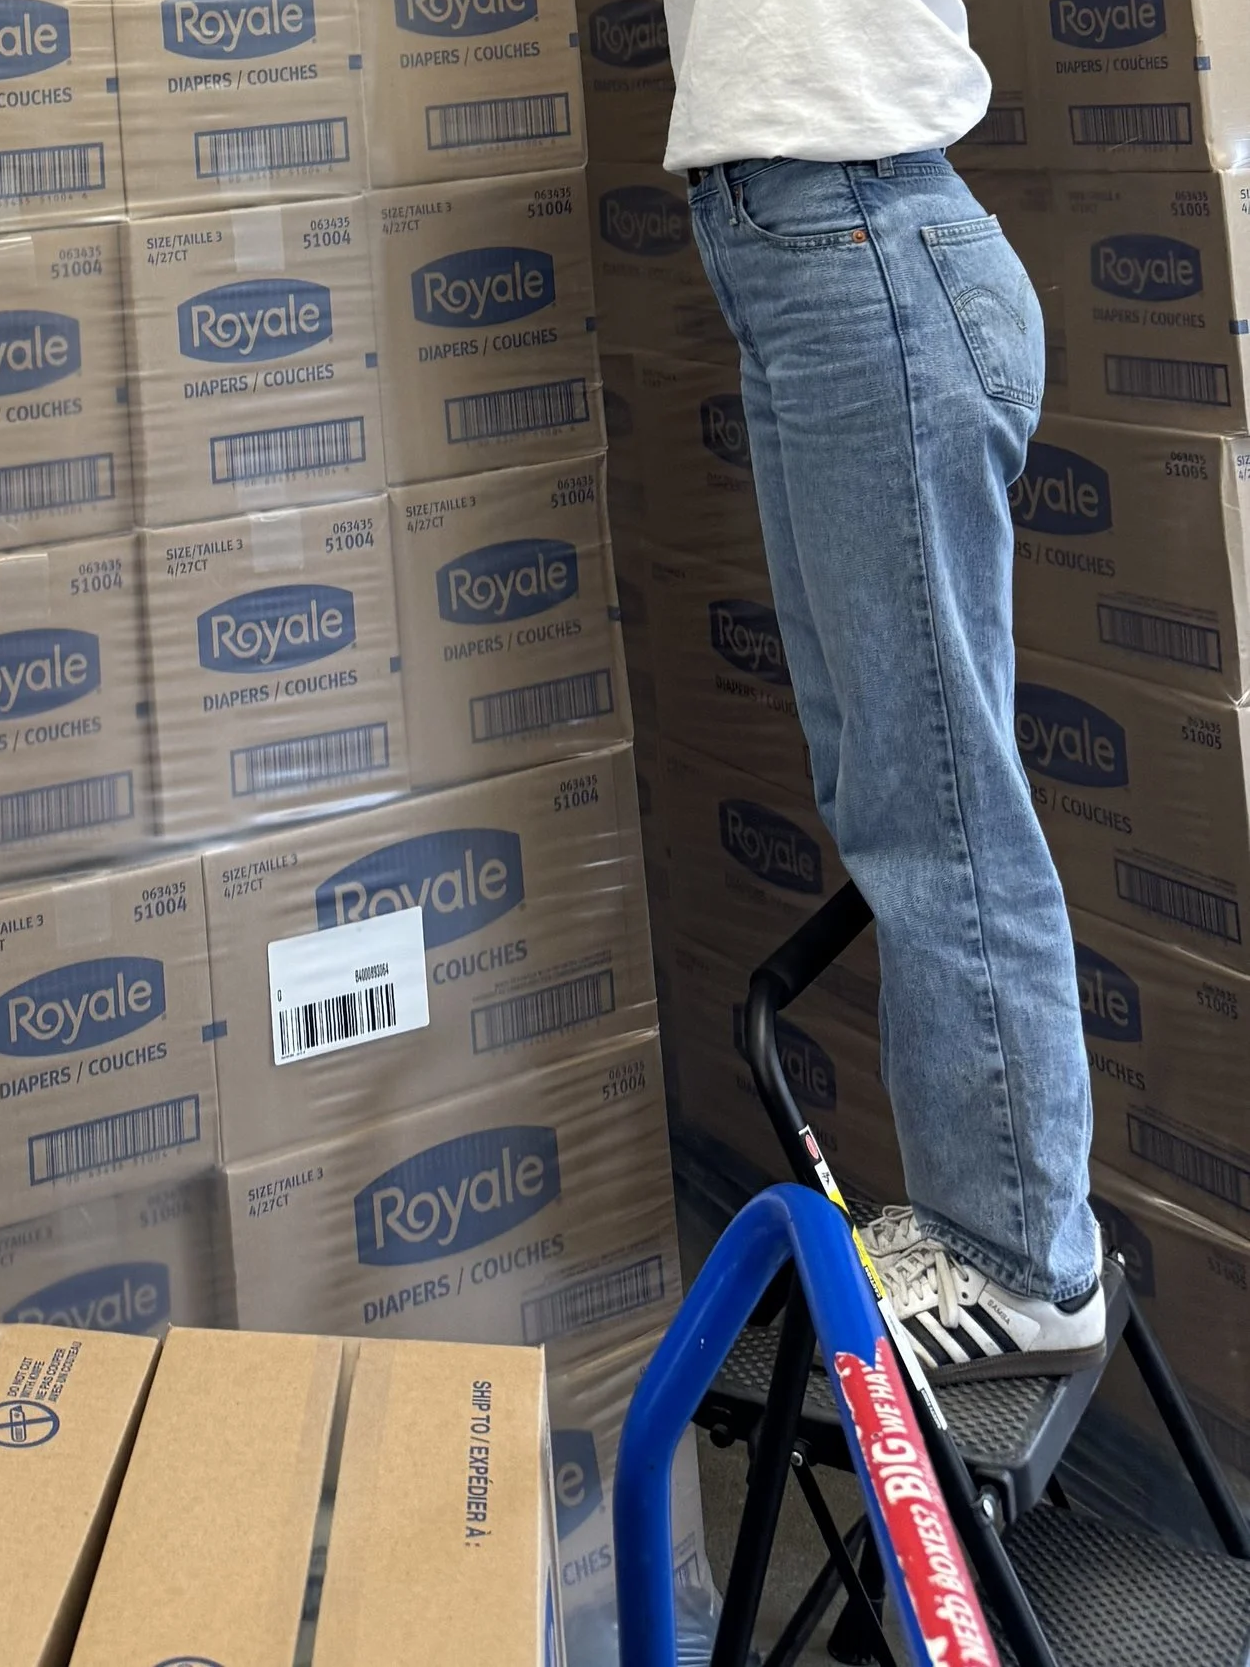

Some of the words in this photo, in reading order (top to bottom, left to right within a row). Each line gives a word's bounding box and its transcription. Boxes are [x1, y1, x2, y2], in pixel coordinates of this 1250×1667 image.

[400, 50, 460, 69] DIAPERS
[473, 42, 540, 63] COUCHES
[1171, 201, 1211, 217] 51005
[303, 231, 351, 249] 51004
[1099, 246, 1194, 286] Royale
[424, 262, 544, 320] Royale
[191, 294, 320, 355] Royale
[449, 553, 566, 617] Royale
[211, 599, 343, 664] Royale
[133, 896, 187, 924] 51004
[8, 972, 152, 1046] Royale
[372, 1147, 545, 1250] Royale
[363, 1274, 450, 1324] DIAPERS
[471, 1234, 564, 1286] COUCHES
[470, 1415, 490, 1434] TO
[472, 1380, 491, 1412] SHIP
[466, 1446, 494, 1522] EXPÉDIER
[871, 1438, 932, 1505] BIG
[910, 1503, 965, 1593] BOXES?
